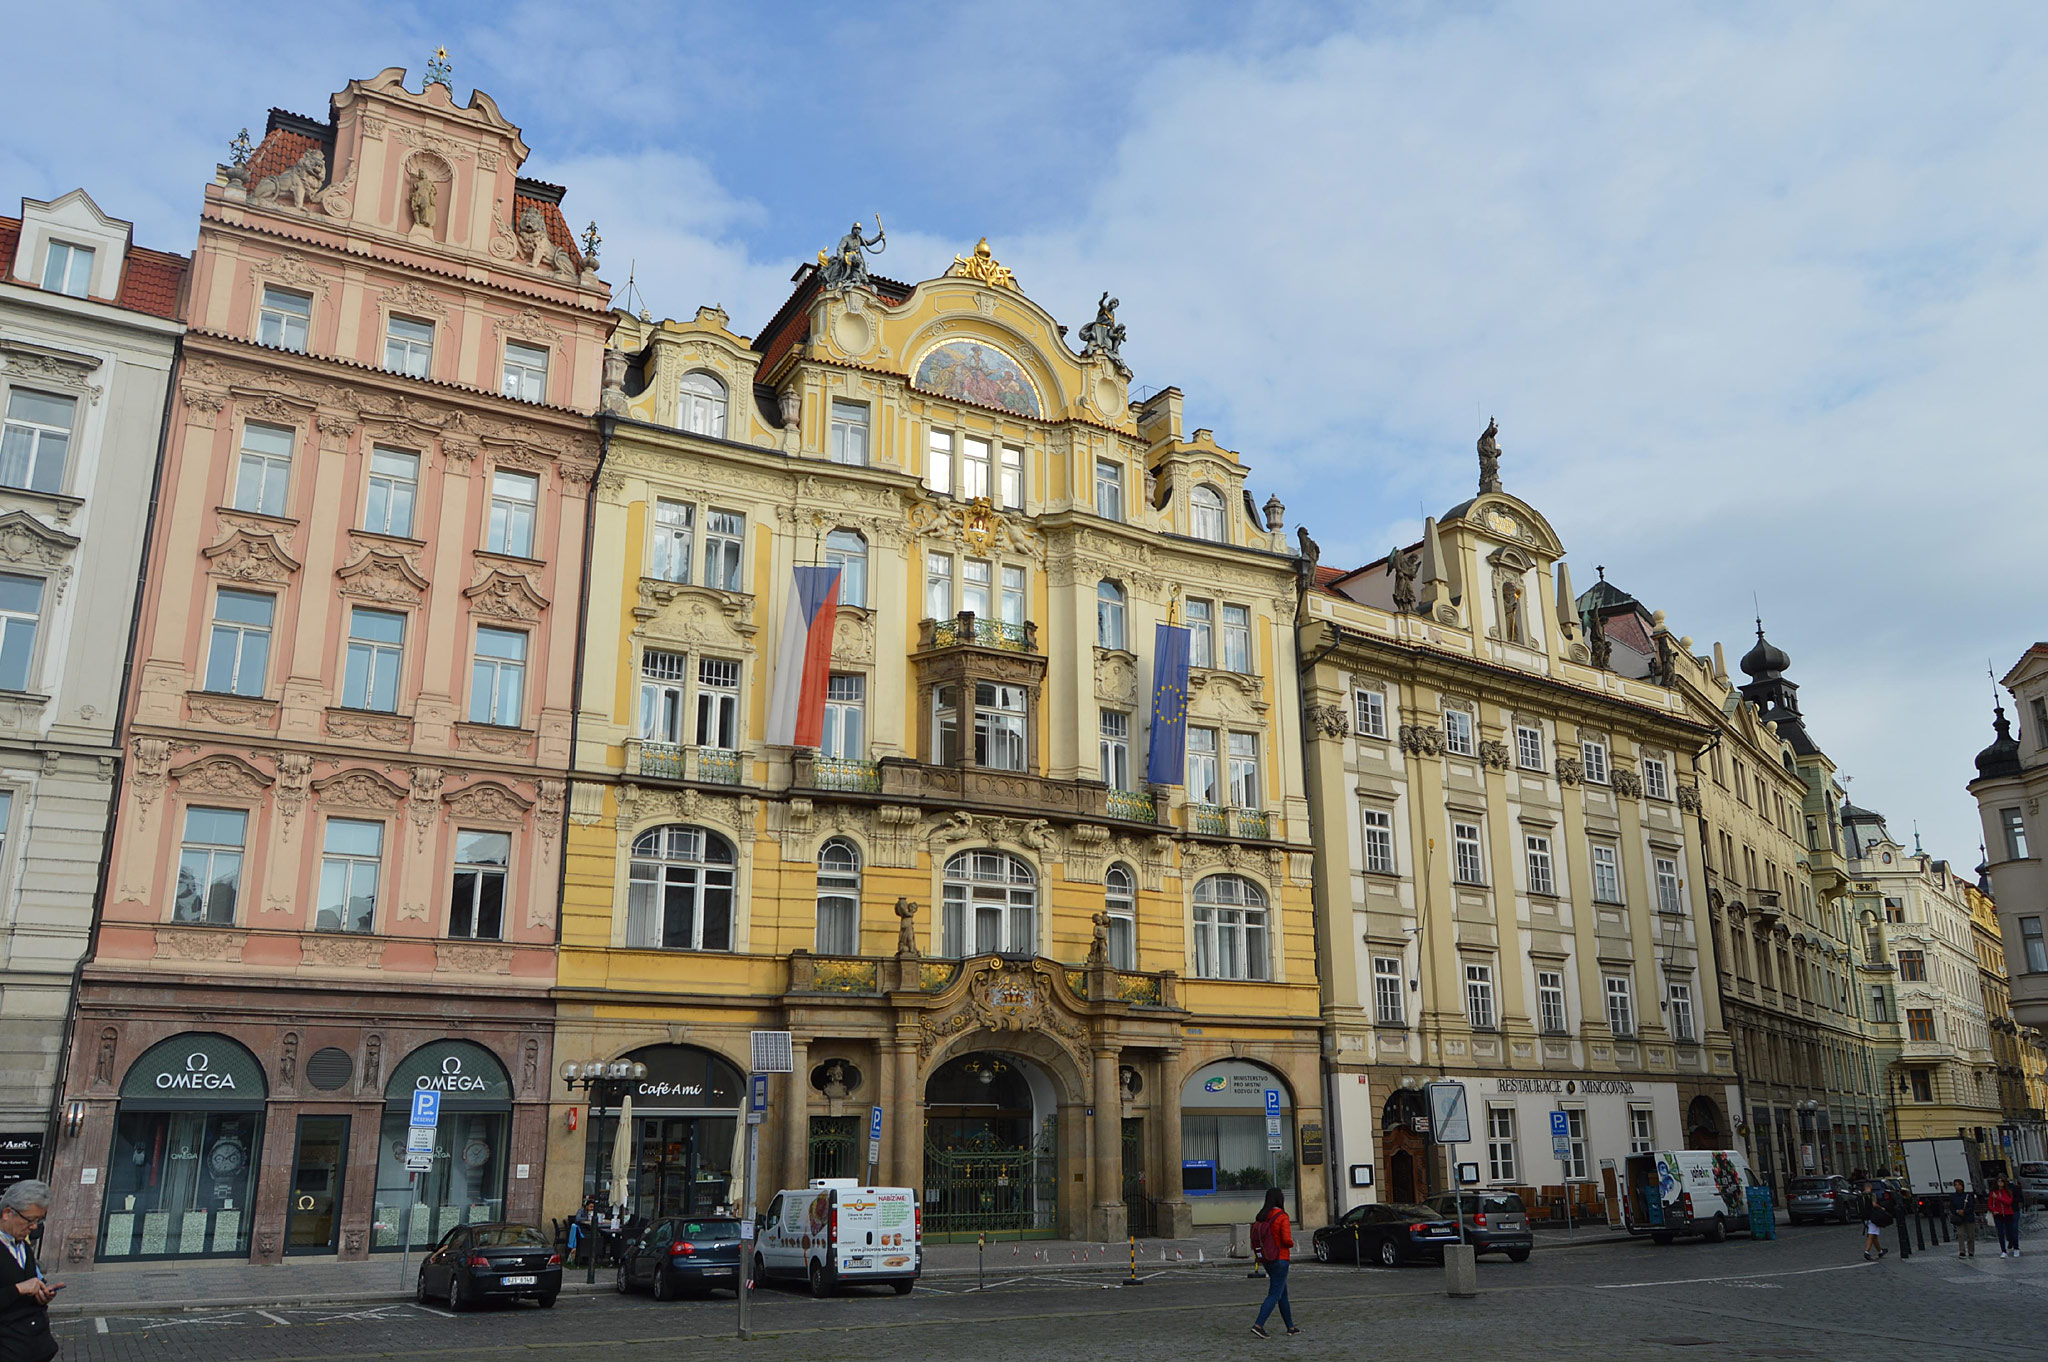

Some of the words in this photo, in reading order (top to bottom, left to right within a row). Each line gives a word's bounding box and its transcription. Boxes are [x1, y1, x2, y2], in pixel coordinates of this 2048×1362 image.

[156, 1073, 235, 1088] OMEGA
[416, 1076, 485, 1090] OMEGA
[1498, 1079, 1562, 1093] RESTAURACE
[1581, 1081, 1634, 1094] MINCOVNA
[638, 1081, 670, 1096] Café
[671, 1084, 702, 1095] Ami
[417, 1095, 434, 1115] P
[1267, 1092, 1277, 1108] P
[873, 1110, 881, 1129] P
[1553, 1114, 1564, 1128] P
